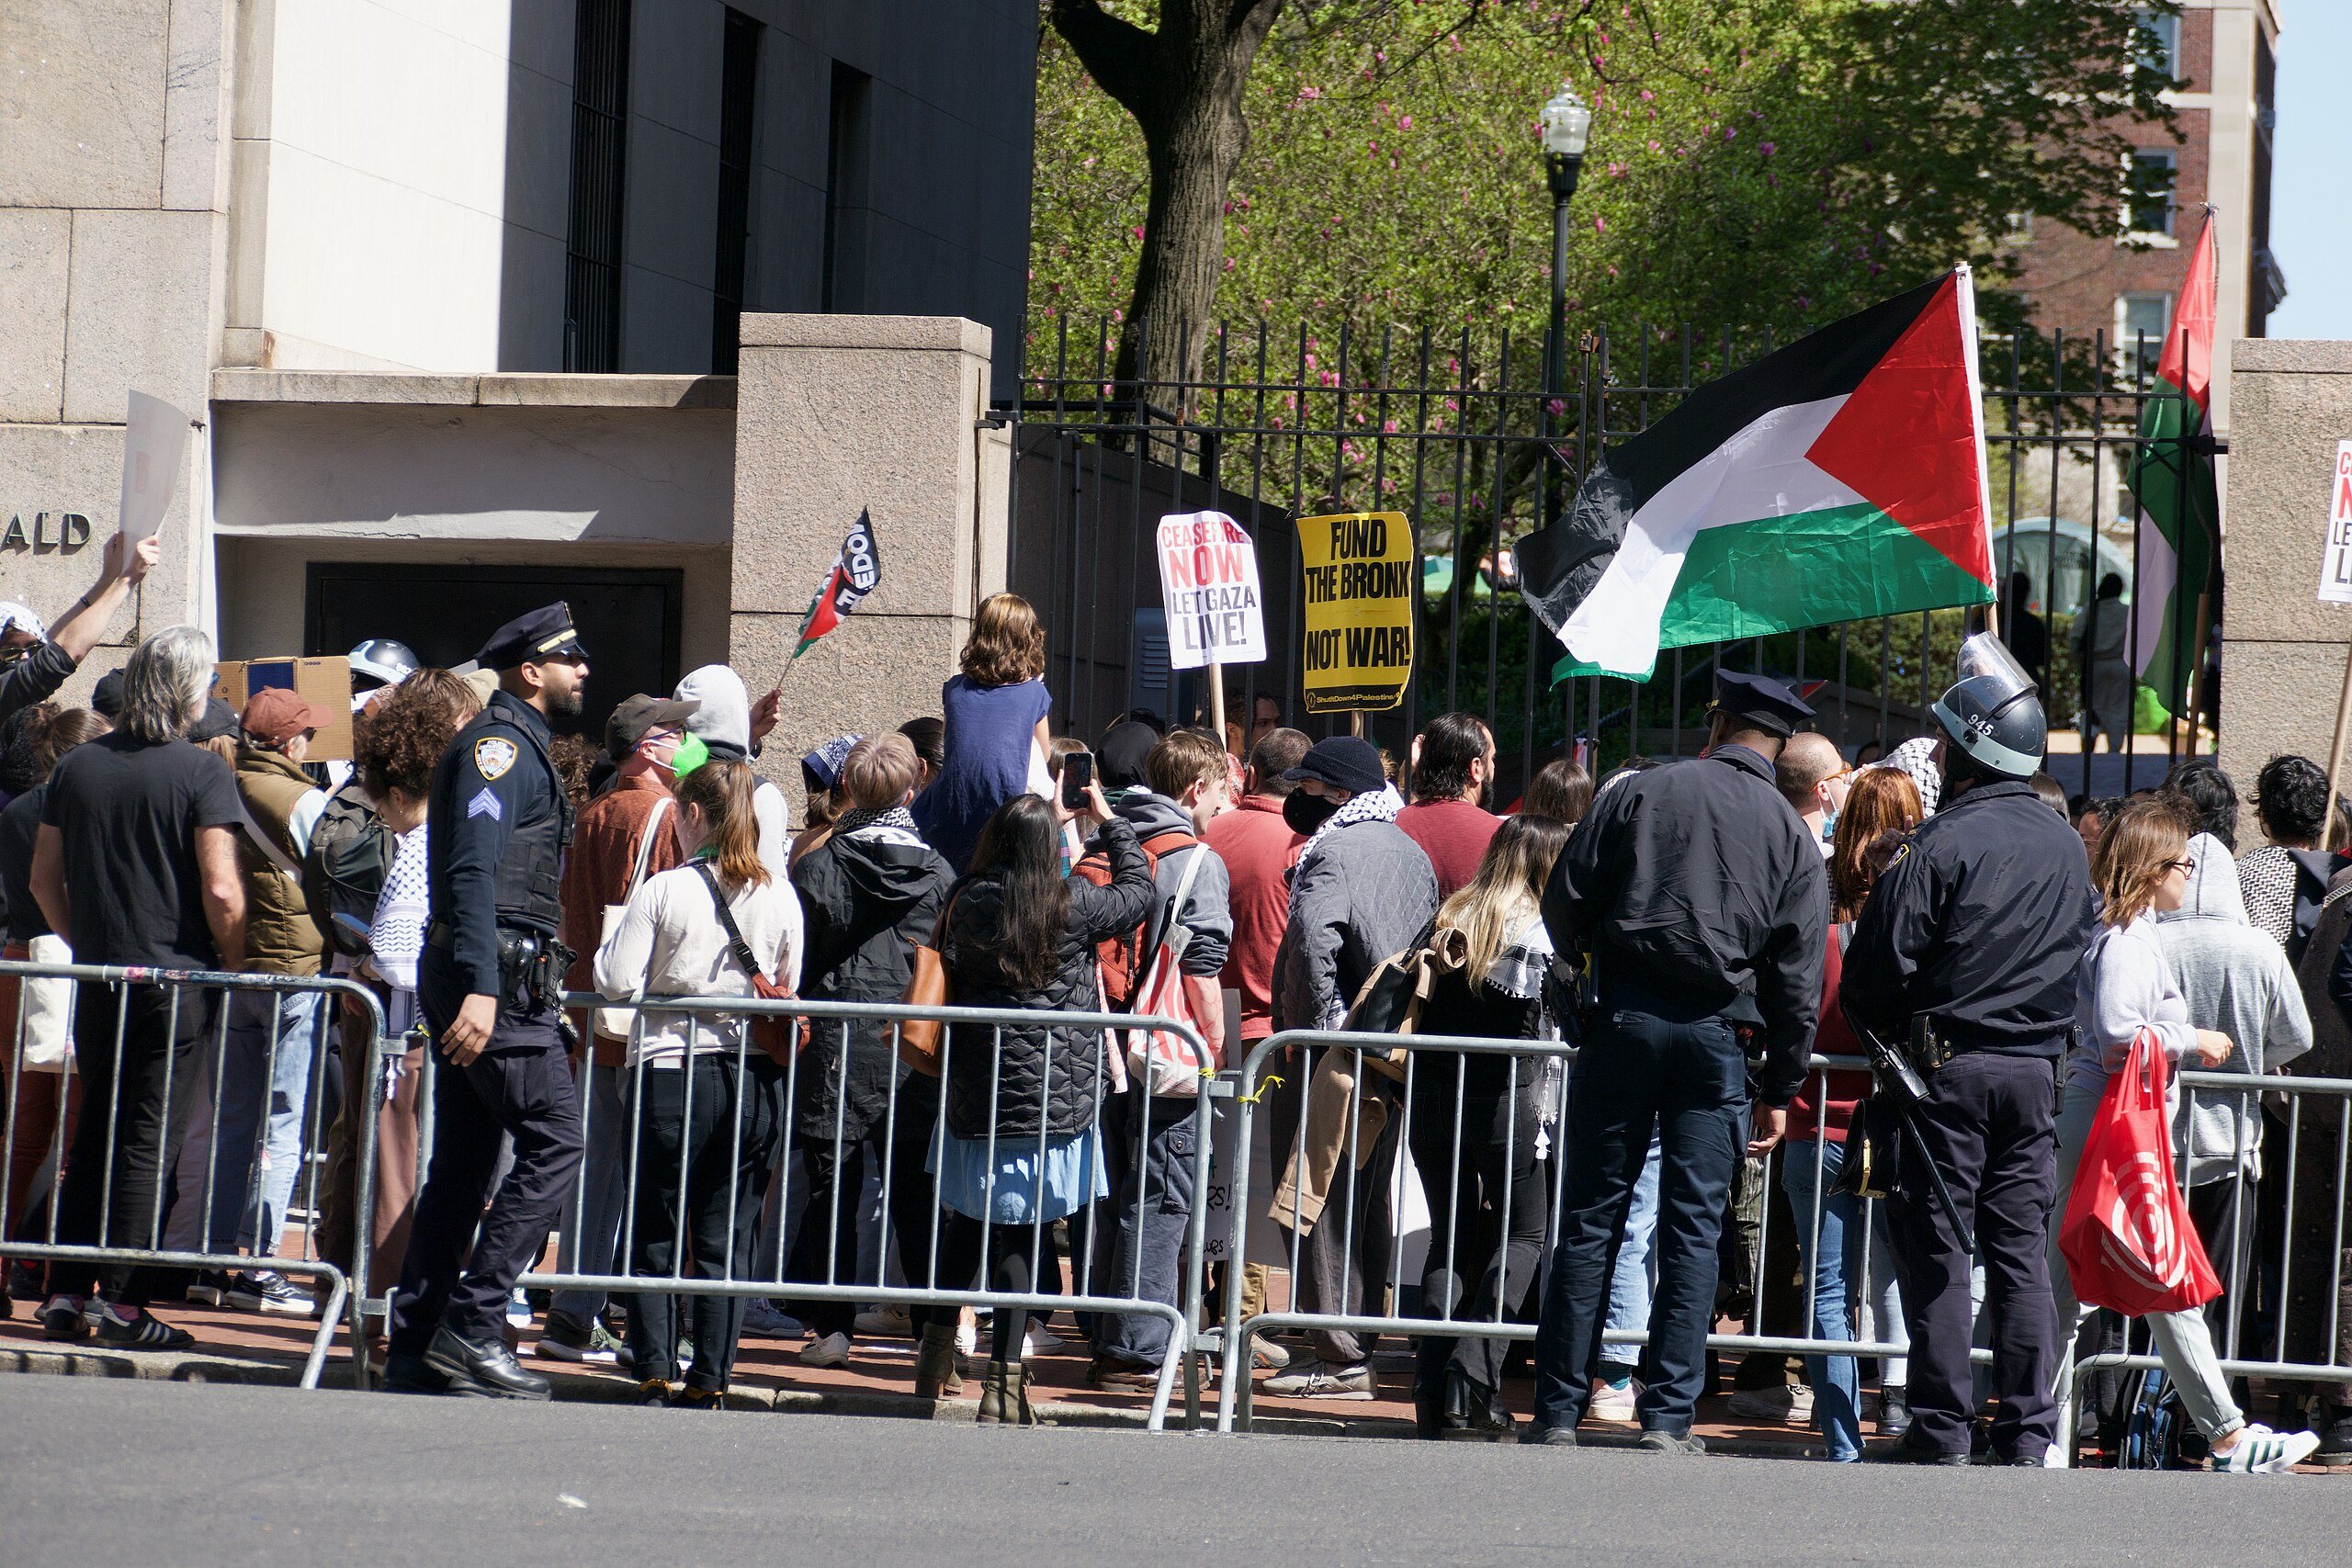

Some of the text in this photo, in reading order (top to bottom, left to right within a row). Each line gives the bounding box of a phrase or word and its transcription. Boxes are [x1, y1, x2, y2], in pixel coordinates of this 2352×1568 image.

[6, 511, 93, 546] ALD
[1330, 518, 1386, 561] FUND
[1169, 545, 1244, 589] NOW
[1306, 560, 1411, 604] THE BRONX
[1172, 585, 1257, 615] LET GAZA
[1182, 611, 1248, 650] LIVE!
[1306, 626, 1410, 671] NOT WAR!
[1967, 714, 1995, 736] 945
